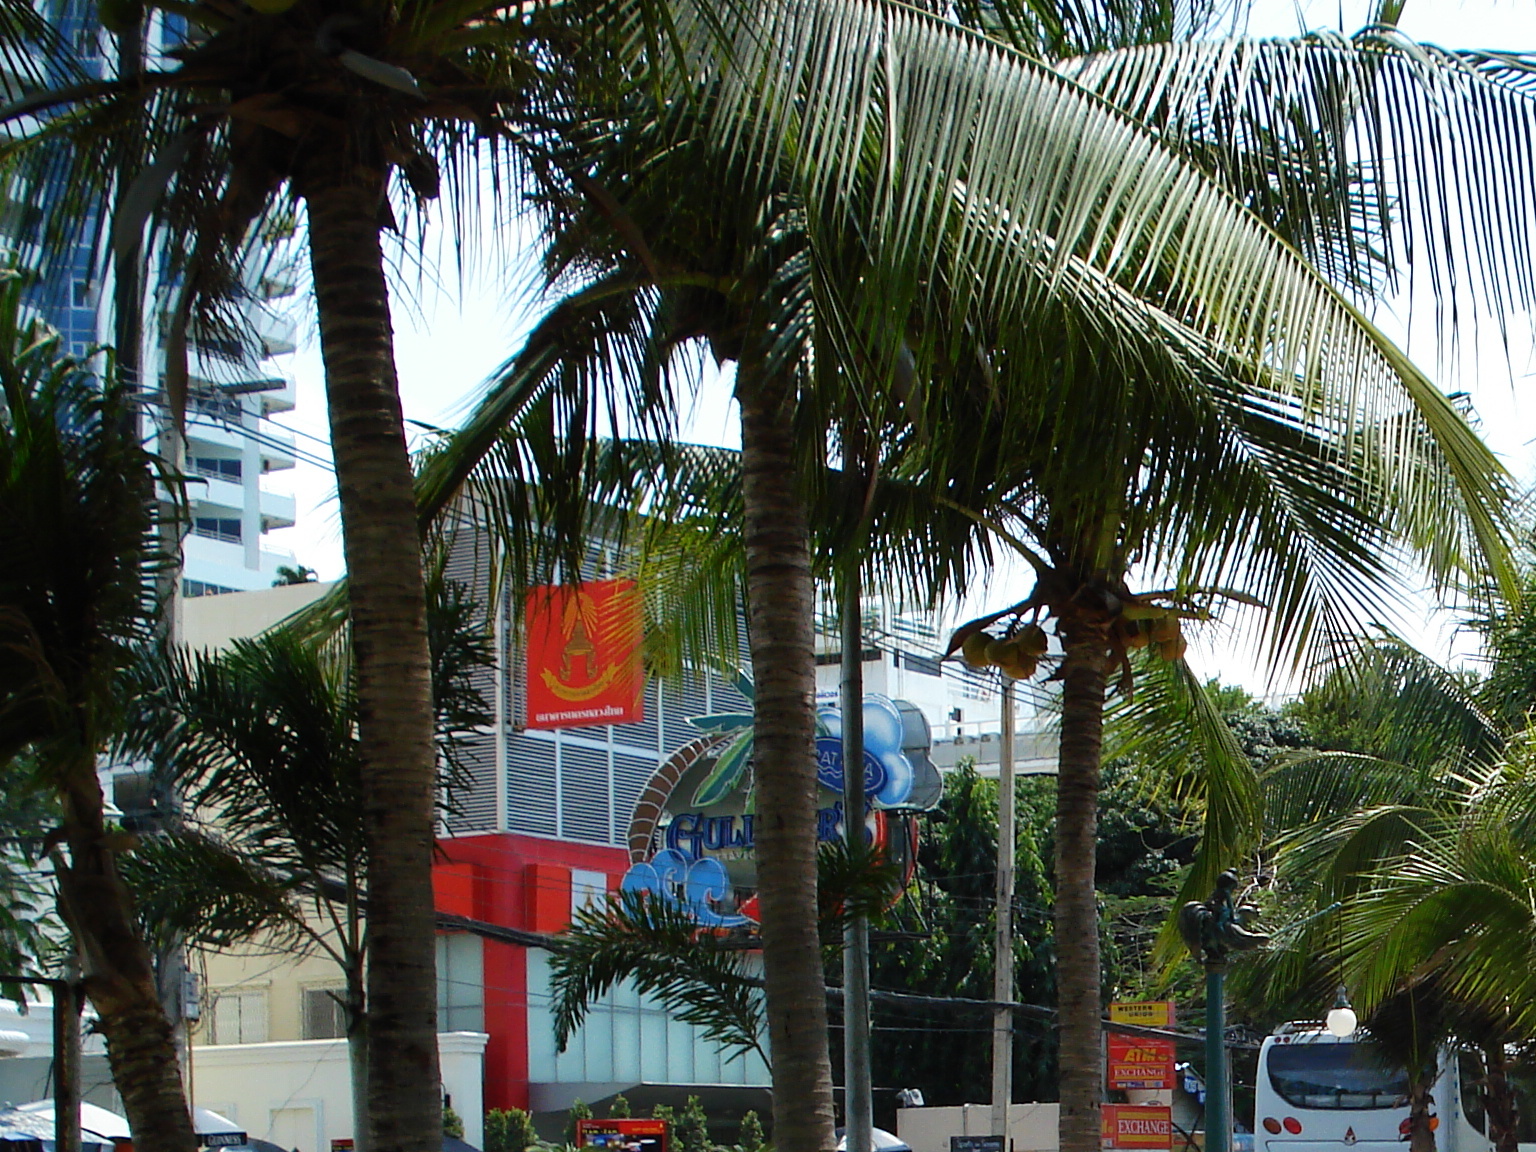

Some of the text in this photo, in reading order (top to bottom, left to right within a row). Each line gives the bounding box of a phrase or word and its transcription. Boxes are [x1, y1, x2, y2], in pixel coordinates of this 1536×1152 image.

[1123, 1048, 1157, 1062] ATM
[1114, 1068, 1166, 1077] EXCHANGE
[1117, 1120, 1170, 1134] EXCHANGE
